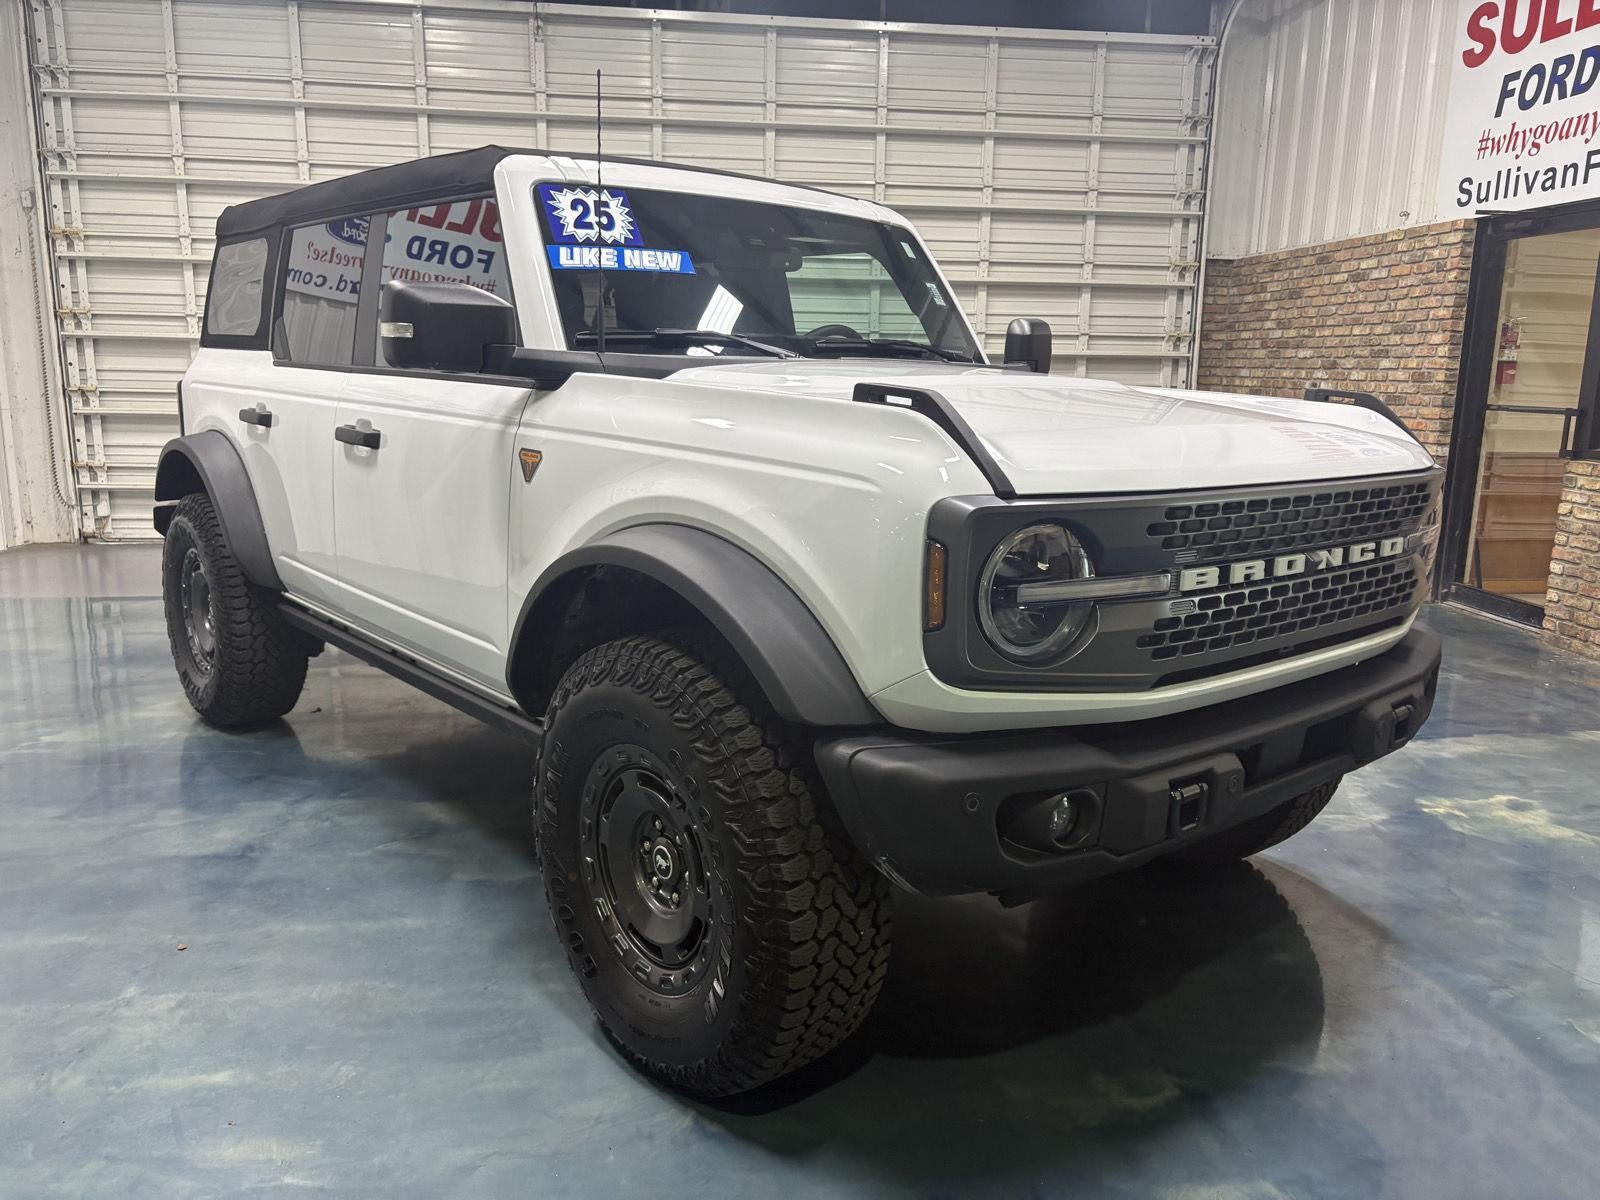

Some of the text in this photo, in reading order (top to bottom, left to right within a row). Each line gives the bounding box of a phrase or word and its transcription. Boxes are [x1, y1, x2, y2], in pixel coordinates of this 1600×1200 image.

[1494, 44, 1600, 118] FORD
[1456, 148, 1600, 207] SullivanF
[570, 197, 617, 232] 25
[559, 246, 682, 272] LIKE NEW
[1180, 536, 1404, 592] BRONCO
